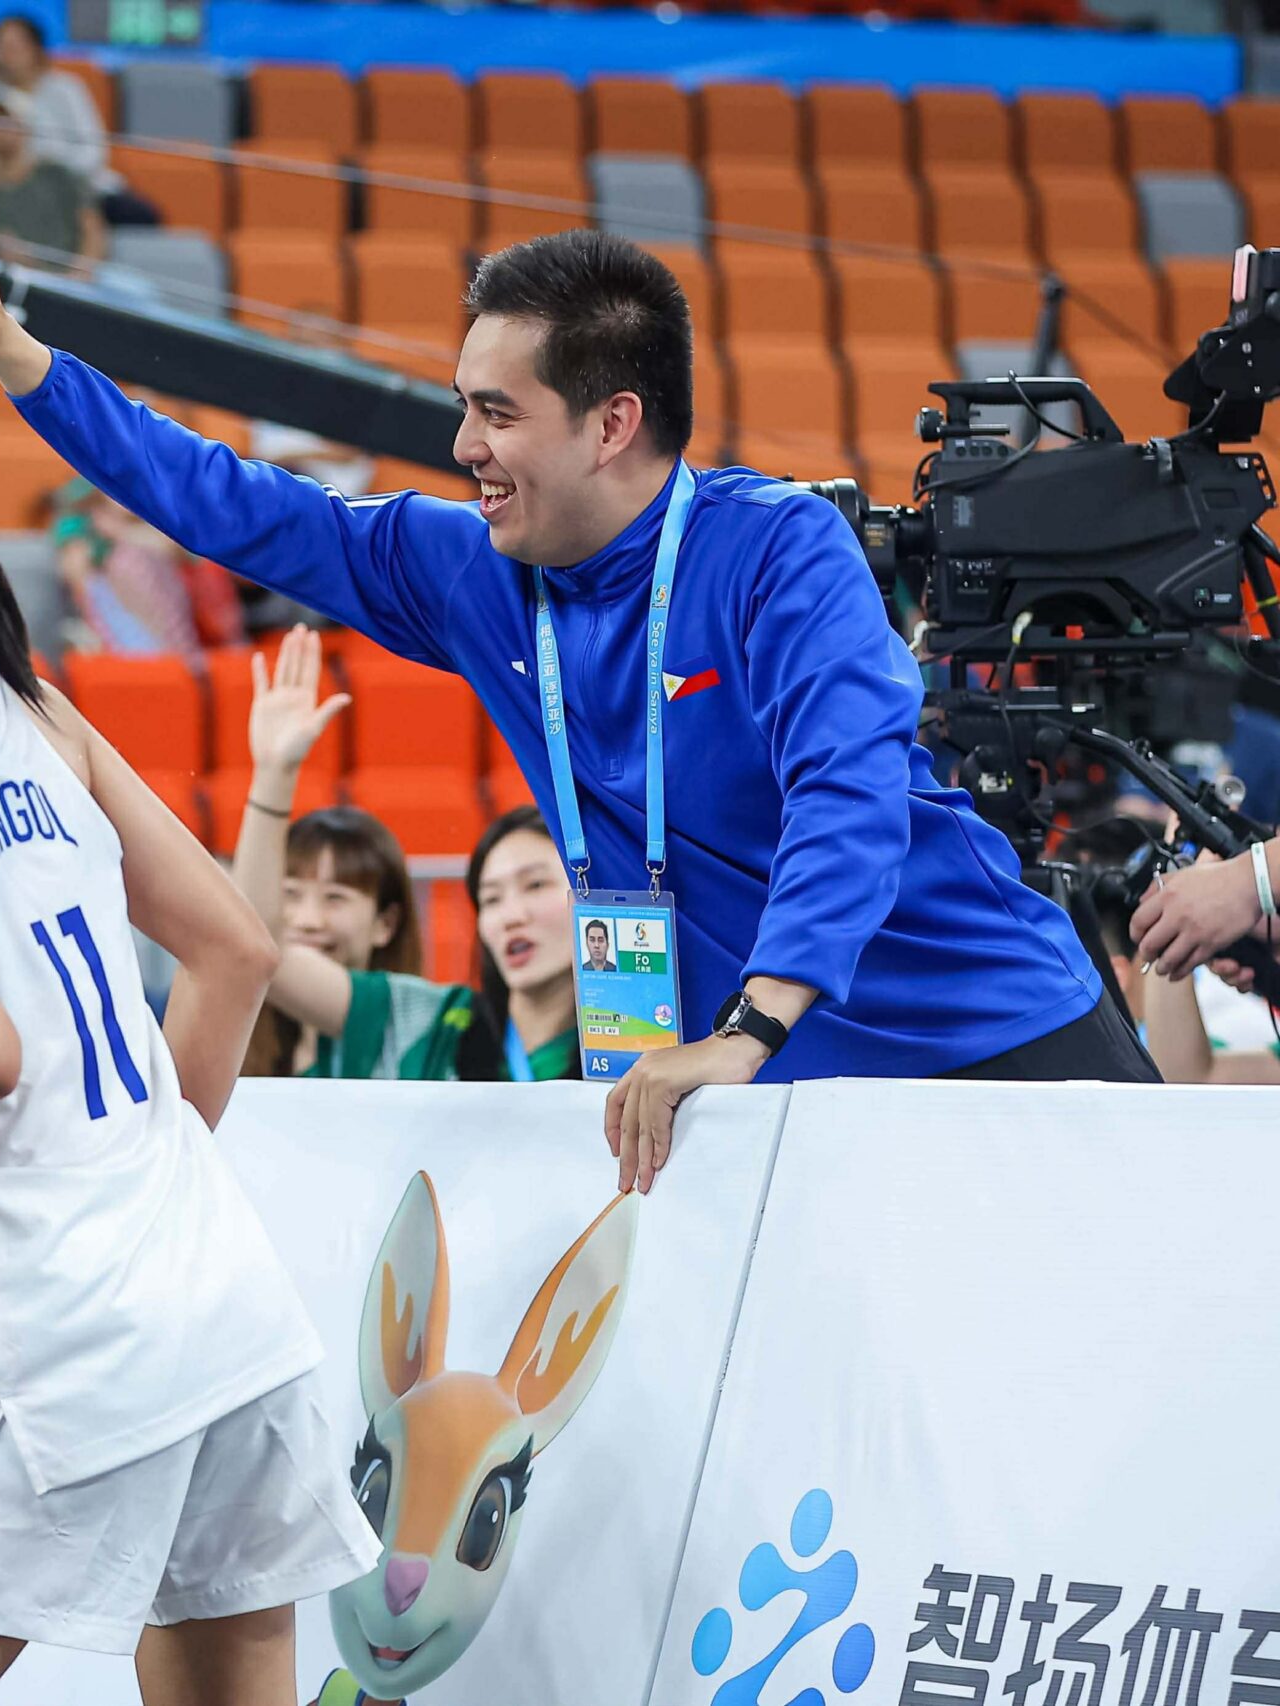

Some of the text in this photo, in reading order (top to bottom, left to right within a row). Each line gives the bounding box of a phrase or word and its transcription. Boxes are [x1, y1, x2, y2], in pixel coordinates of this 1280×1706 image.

[540, 624, 556, 677] 相约三亚
[648, 621, 664, 734] See ya in Sanya
[30, 905, 149, 1121] 11
[591, 1056, 609, 1072] AS
